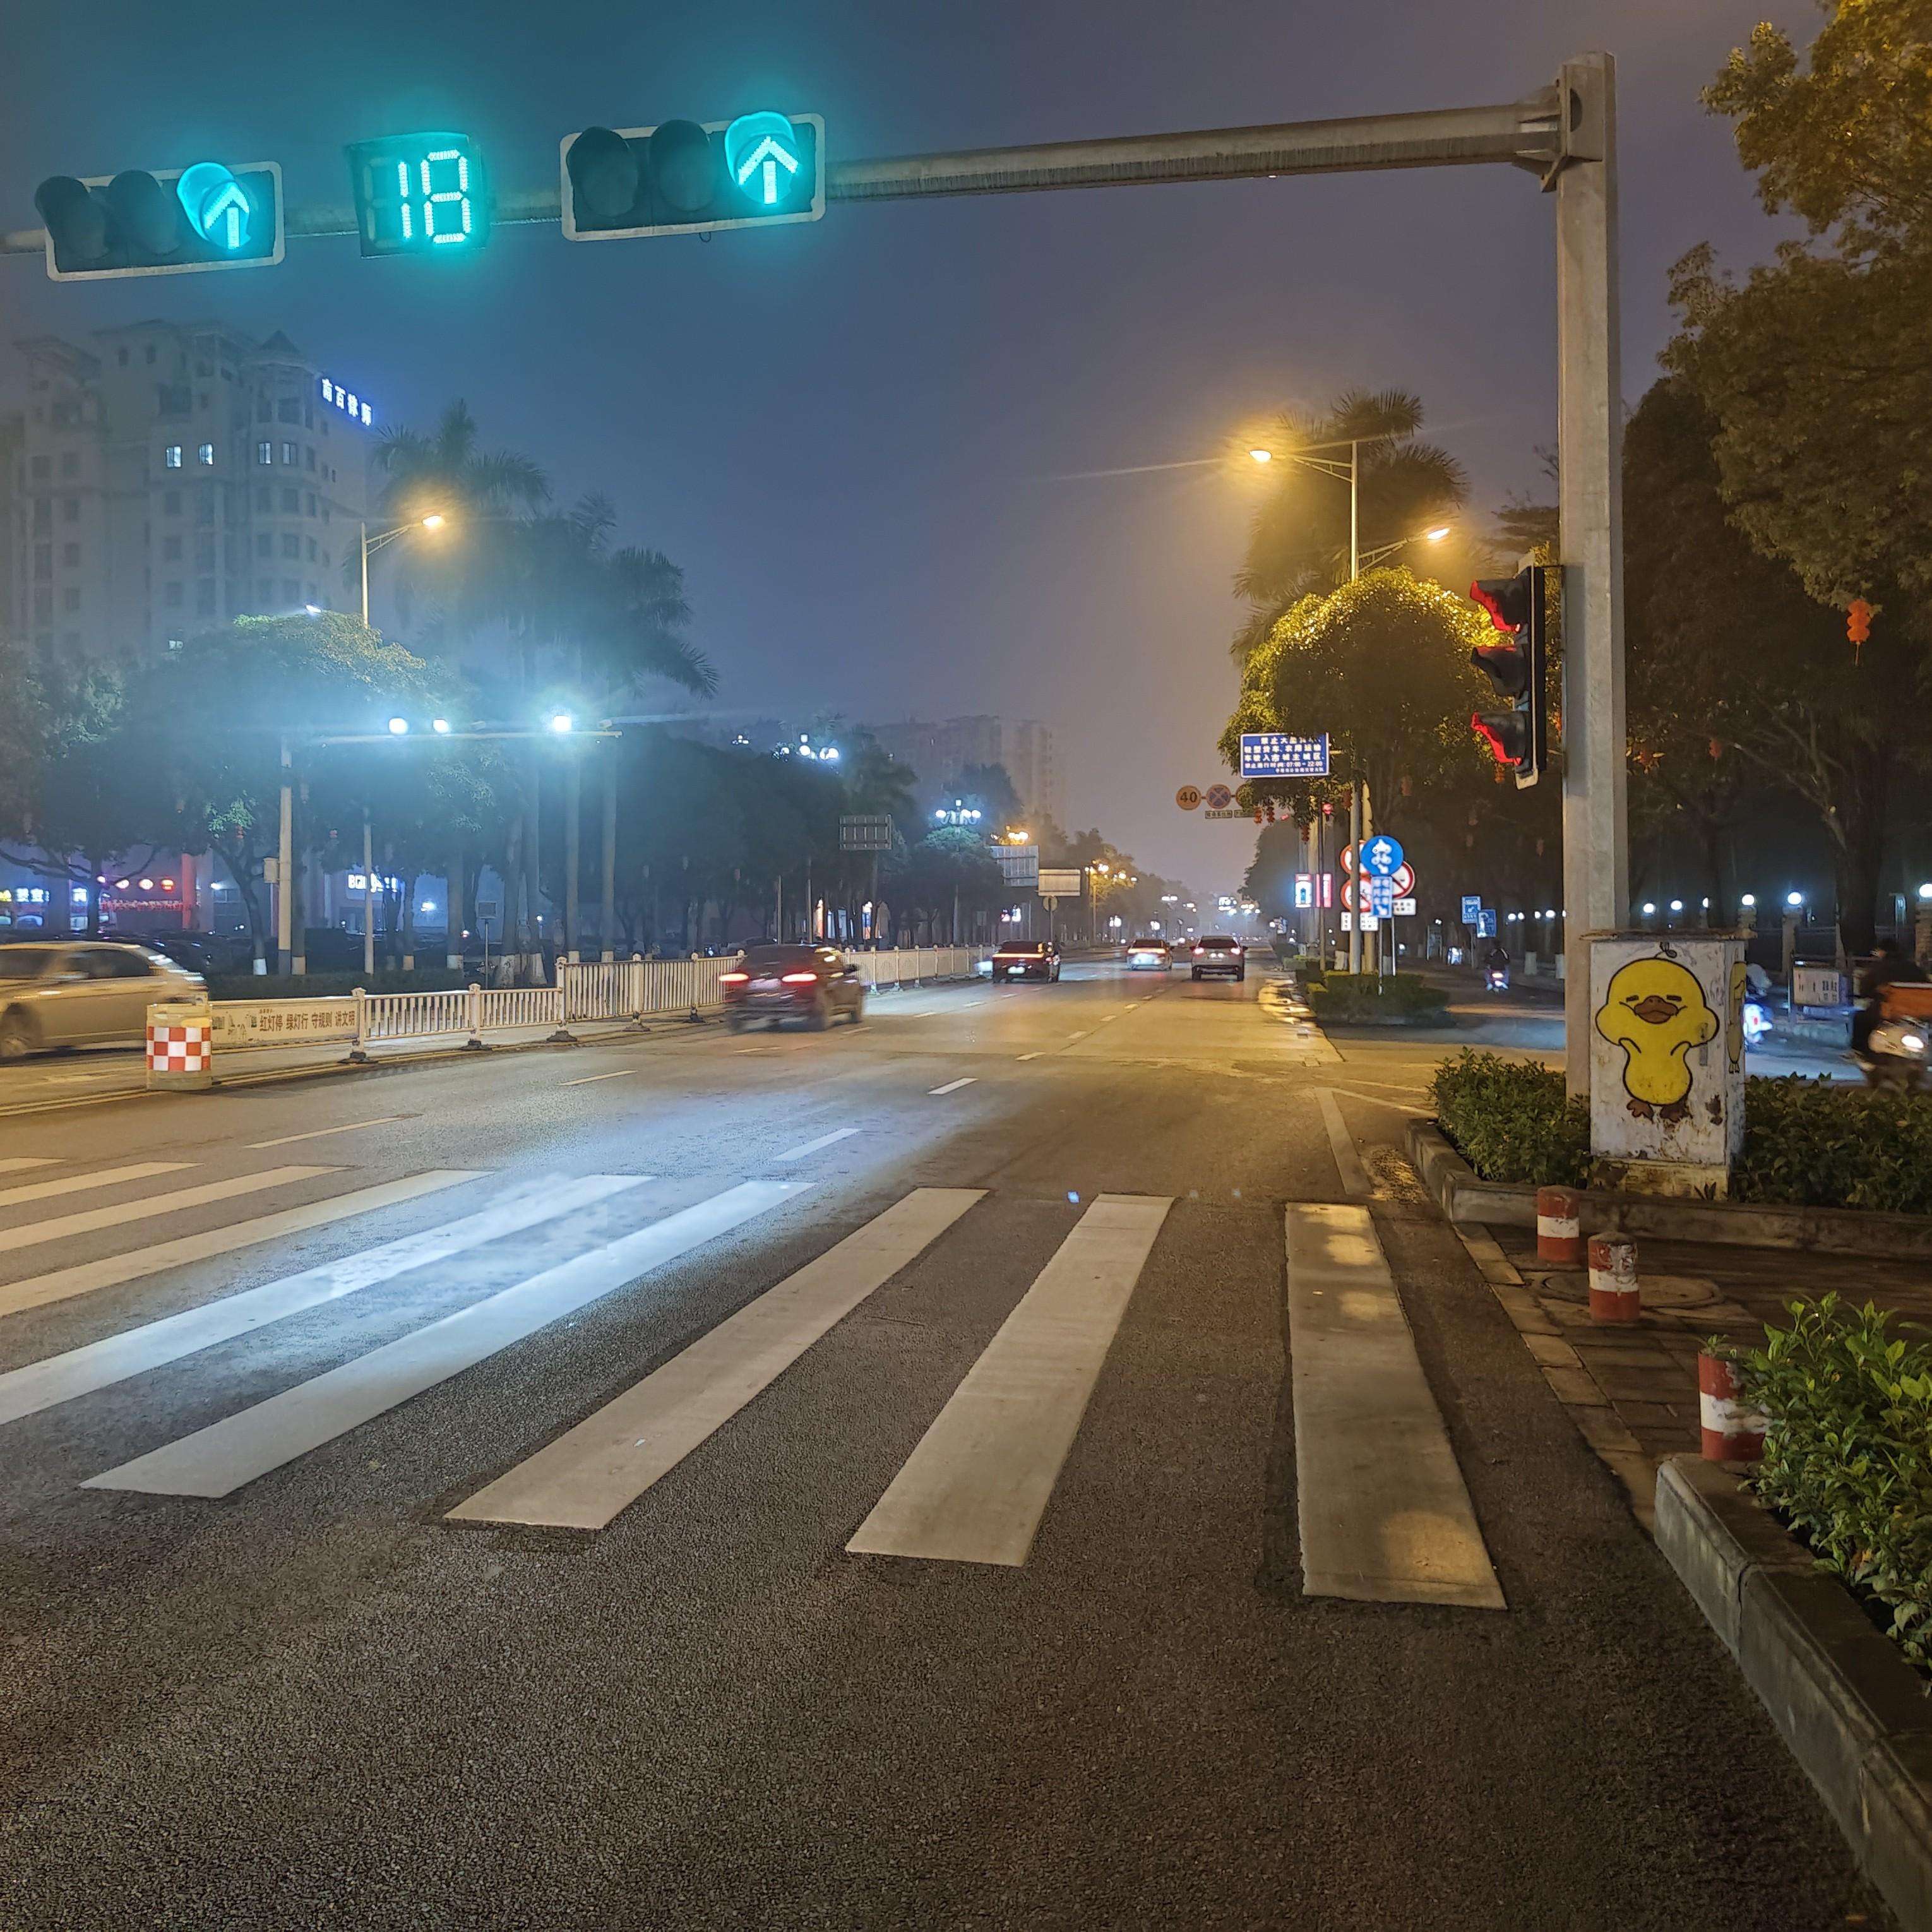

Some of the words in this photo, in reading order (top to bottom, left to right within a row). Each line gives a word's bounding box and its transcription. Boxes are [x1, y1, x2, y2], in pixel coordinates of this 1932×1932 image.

[397, 149, 472, 244] 18
[1180, 791, 1198, 803] 40
[259, 1014, 283, 1032] 红灯停
[286, 1013, 308, 1030] 绿灯行
[311, 1011, 332, 1029] 守规则
[335, 1010, 355, 1027] 讲文明
